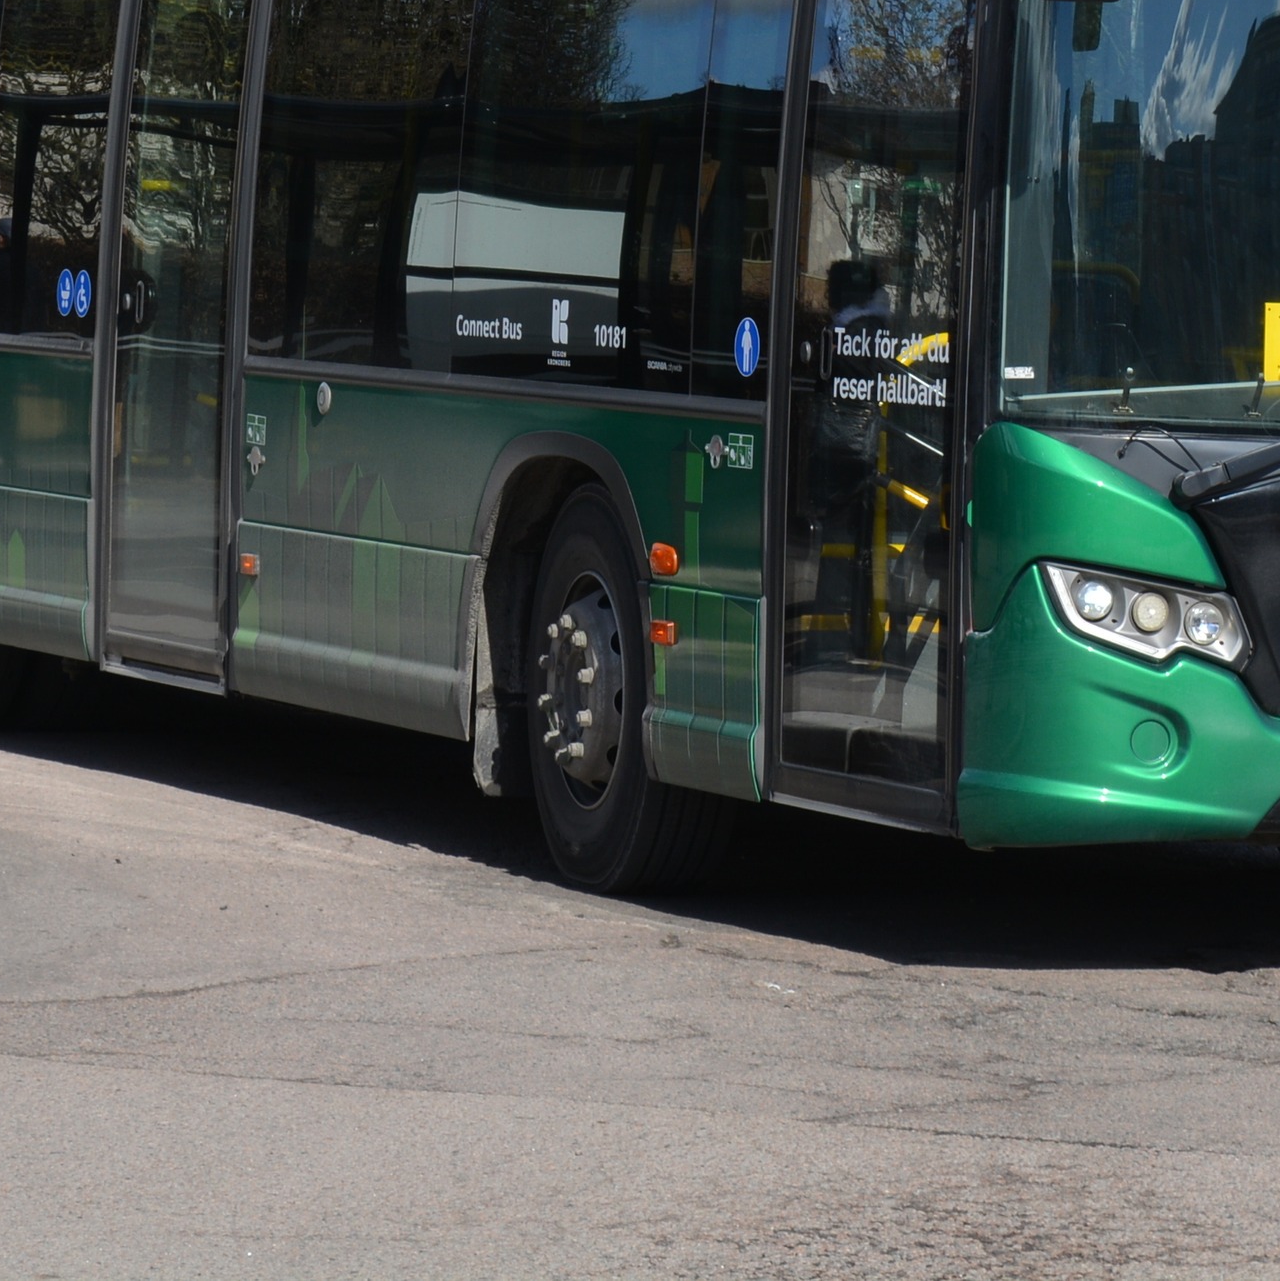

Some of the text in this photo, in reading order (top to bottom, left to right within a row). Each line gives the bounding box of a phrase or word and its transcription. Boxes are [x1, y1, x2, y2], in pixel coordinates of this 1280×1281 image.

[456, 314, 523, 340] Connect Bus
[593, 324, 627, 349] 10181
[834, 327, 950, 364] Tack för att du
[833, 372, 947, 408] reser hållbart!
